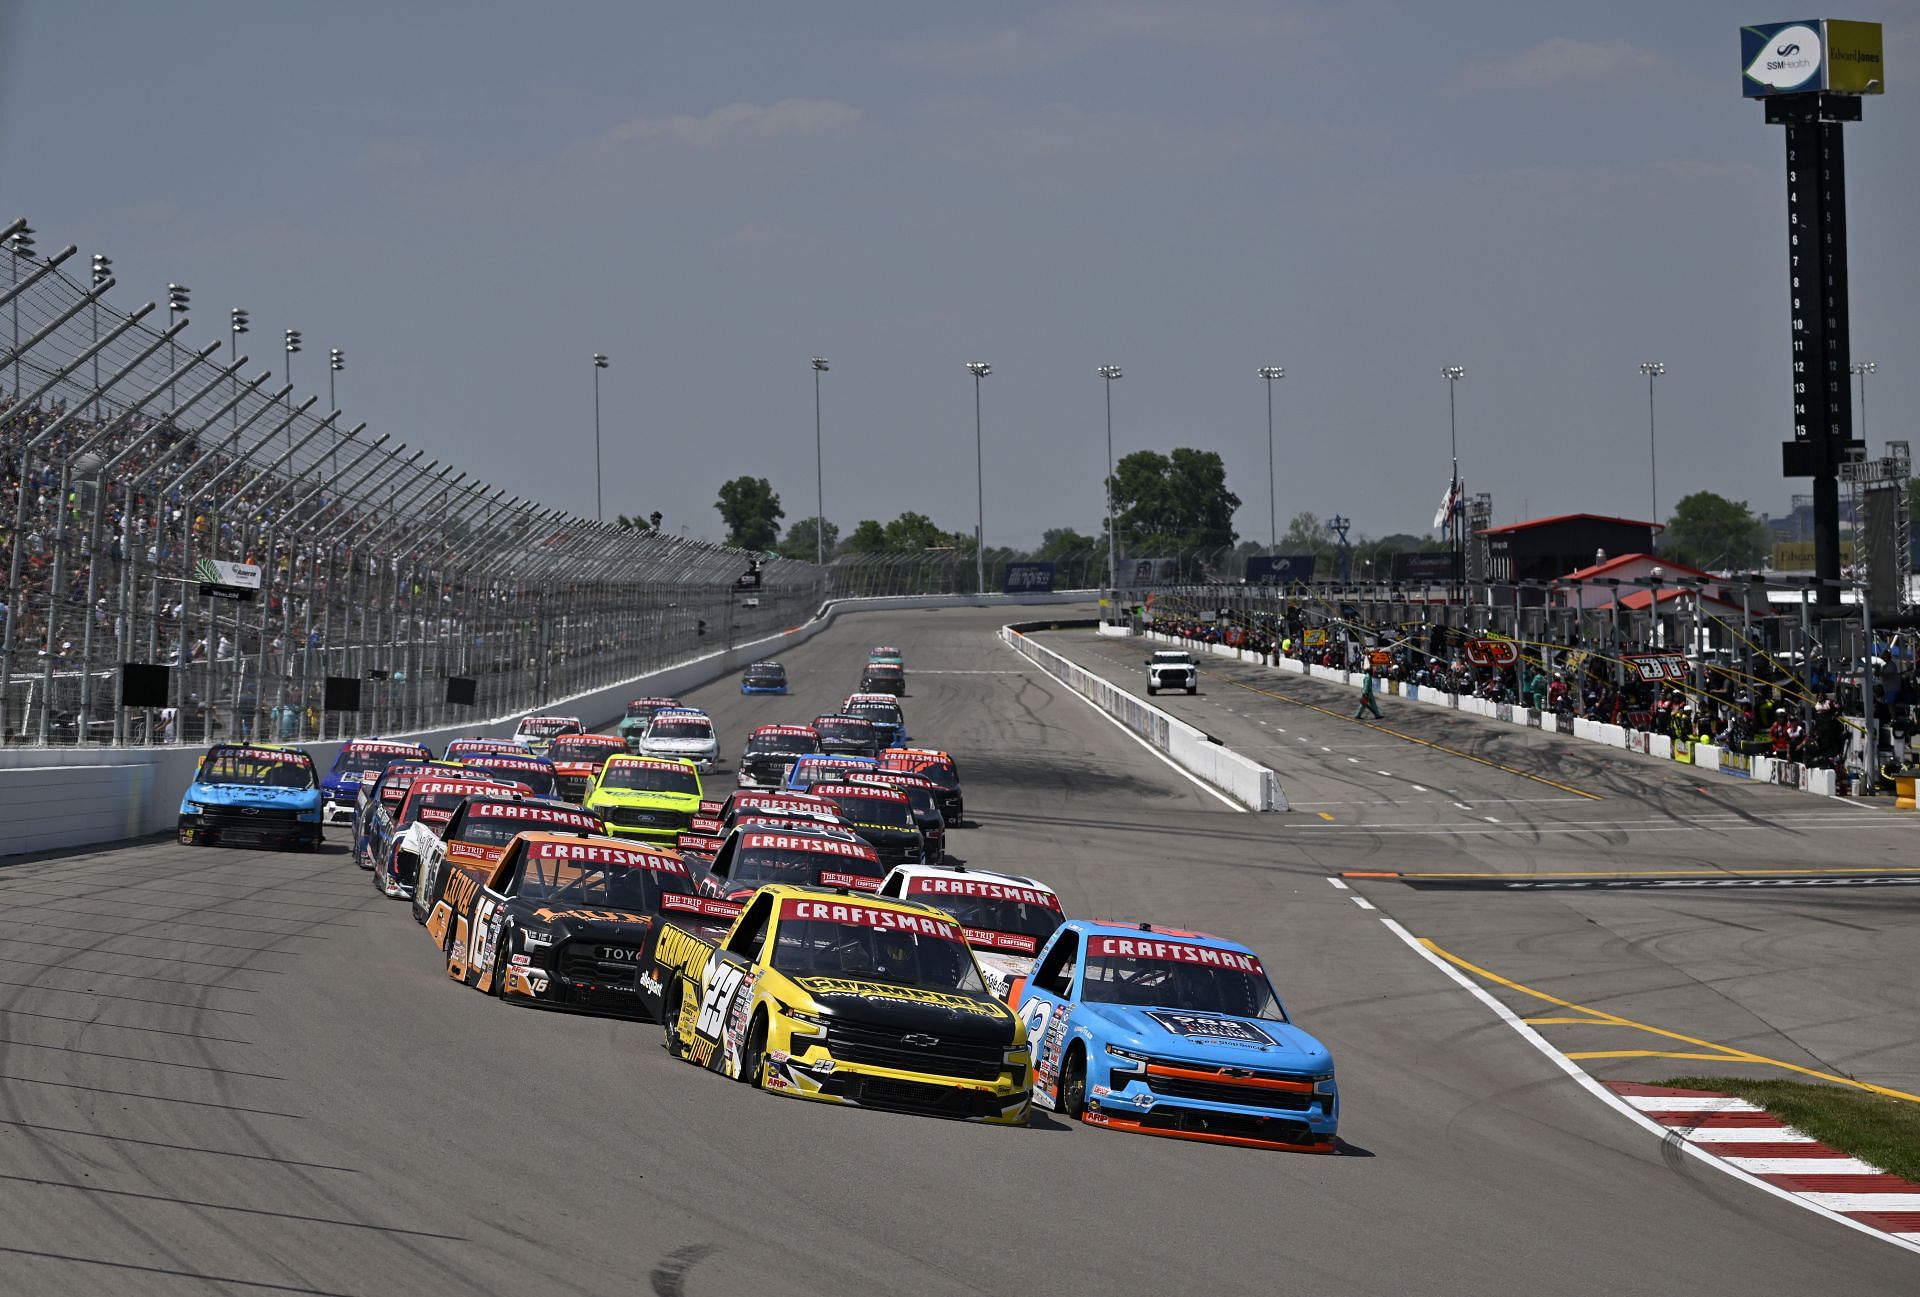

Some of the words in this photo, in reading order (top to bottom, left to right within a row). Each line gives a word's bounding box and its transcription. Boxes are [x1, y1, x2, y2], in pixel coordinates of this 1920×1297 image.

[1790, 130, 1795, 139] 1
[1790, 151, 1795, 160] 2
[1790, 171, 1796, 182] 3
[1791, 192, 1797, 202] 4
[1791, 213, 1797, 224] 5
[1792, 235, 1798, 245] 6
[1793, 256, 1799, 266] 7
[1793, 277, 1799, 287] 8
[1794, 298, 1800, 309] 9
[1793, 319, 1803, 330] 10
[1794, 341, 1803, 351] 11
[1794, 362, 1804, 372] 12
[1795, 383, 1805, 393] 13
[1795, 404, 1805, 414] 14
[1796, 425, 1806, 435] 15
[525, 718, 580, 726] CRAFTSMAN
[760, 729, 814, 737] CRAFTSMAN
[560, 737, 621, 747] CRAFTSMAN
[350, 744, 424, 756] CRAFTSMAN
[456, 743, 523, 753] CRAFTSMAN
[217, 749, 303, 762] CRAFTSMAN
[885, 753, 946, 764] CRAFTSMAN
[467, 757, 548, 772] CRAFTSMAN
[614, 759, 688, 772] CRAFTSMAN
[805, 758, 873, 769] CRAFTSMAN
[850, 773, 923, 786] CRAFTSMAN
[818, 785, 899, 799] CRAFTSMAN
[741, 798, 832, 814] CRAFTSMAN
[480, 805, 595, 828] CRAFTSMAN
[705, 820, 718, 828] TRIP
[693, 838, 707, 846] TRIP
[751, 836, 865, 857] CRAFTSMAN
[452, 844, 466, 852] THE
[466, 846, 485, 855] TRIP
[541, 844, 677, 872] CRAFTSMAN
[822, 872, 836, 880] THE
[837, 874, 854, 883] TRIP
[922, 879, 1050, 907] CRAFTSMAN
[664, 894, 681, 904] THE
[682, 896, 702, 908] TRIP
[707, 905, 739, 916] CRAFTSMAN
[797, 903, 953, 938] CRAFTSMAN
[963, 929, 974, 937] HE
[974, 930, 995, 941] TRIP
[1000, 938, 1032, 949] CRAFTSMAN
[655, 922, 714, 981] CHAMPION
[1103, 939, 1253, 972] CRAFTSMAN
[530, 977, 550, 993] 16
[696, 962, 745, 1040] 23
[812, 1059, 836, 1074] 23
[767, 1077, 788, 1088] ARP
[1132, 1093, 1154, 1108] 43
[1087, 1112, 1108, 1122] ARP
